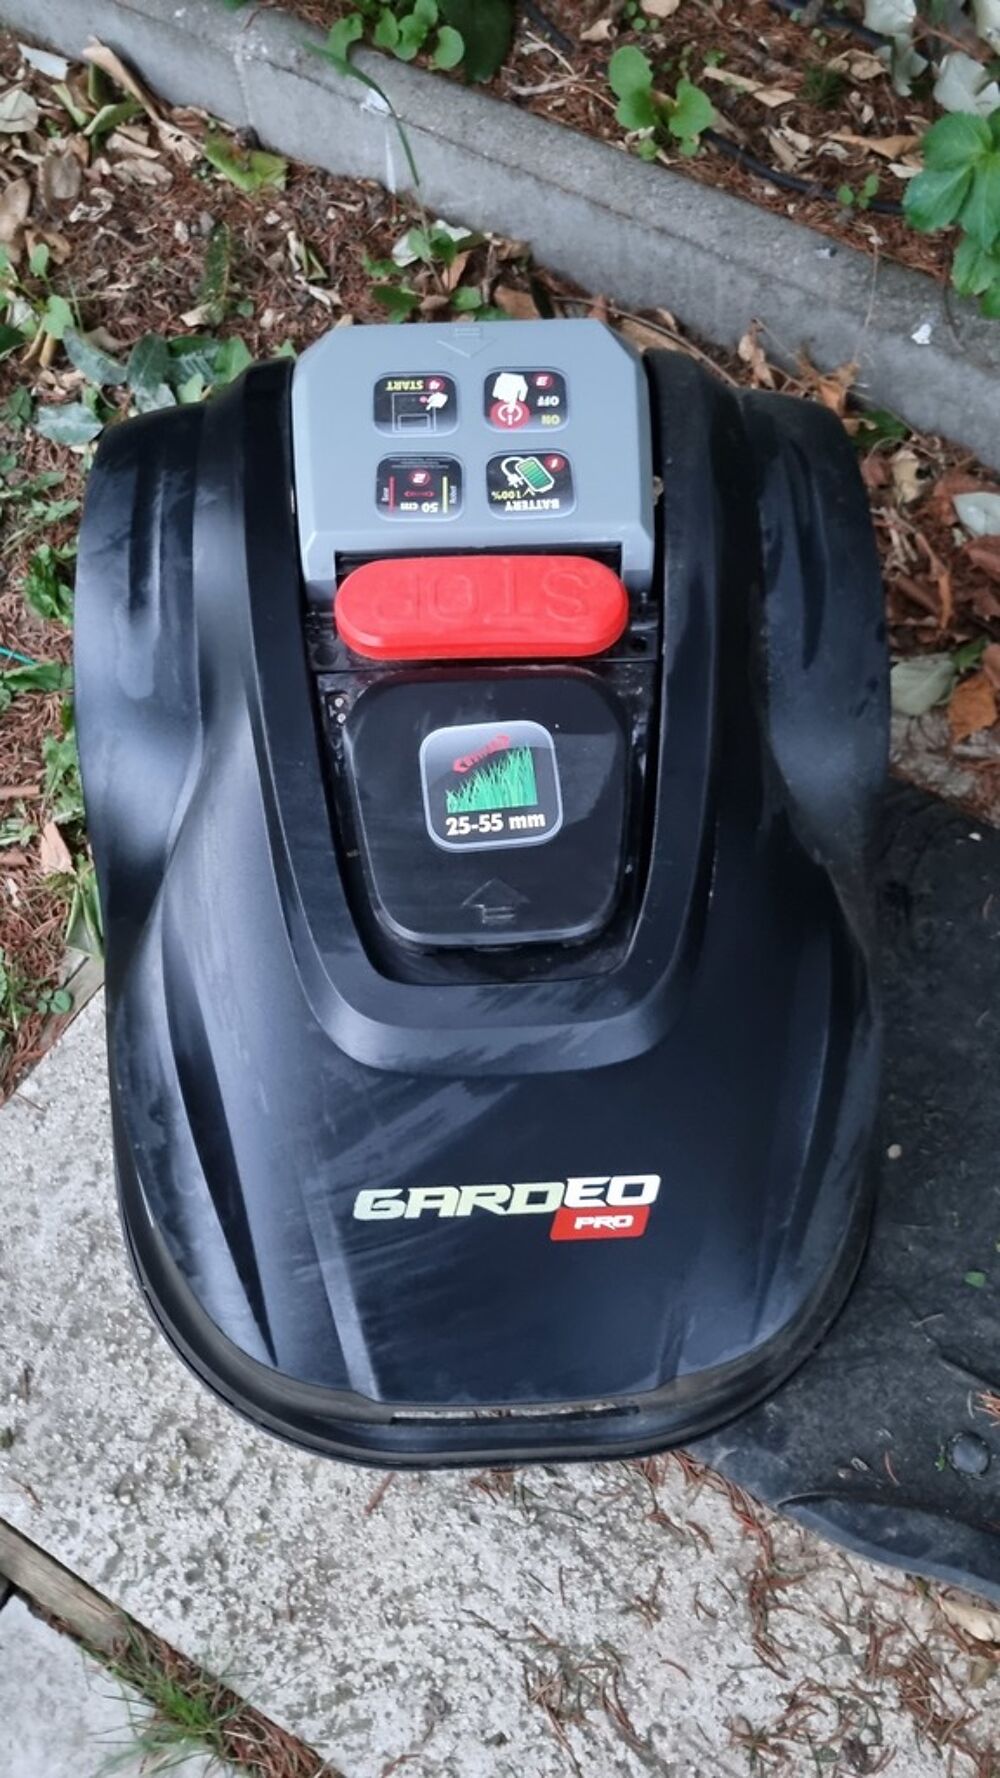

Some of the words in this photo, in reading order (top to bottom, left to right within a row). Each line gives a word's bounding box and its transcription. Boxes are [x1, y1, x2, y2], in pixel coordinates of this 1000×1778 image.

[385, 380, 424, 392] START
[537, 395, 560, 407] OFF
[541, 414, 561, 426] ON
[491, 489, 522, 500] 100%
[400, 501, 419, 512] cm
[421, 501, 439, 513] 50
[505, 498, 560, 512] BATTERY
[371, 564, 592, 623] STOP
[445, 813, 504, 836] 25-55
[508, 813, 546, 830] mm
[353, 1174, 661, 1221] GARDEO
[574, 1214, 634, 1230] PRO
